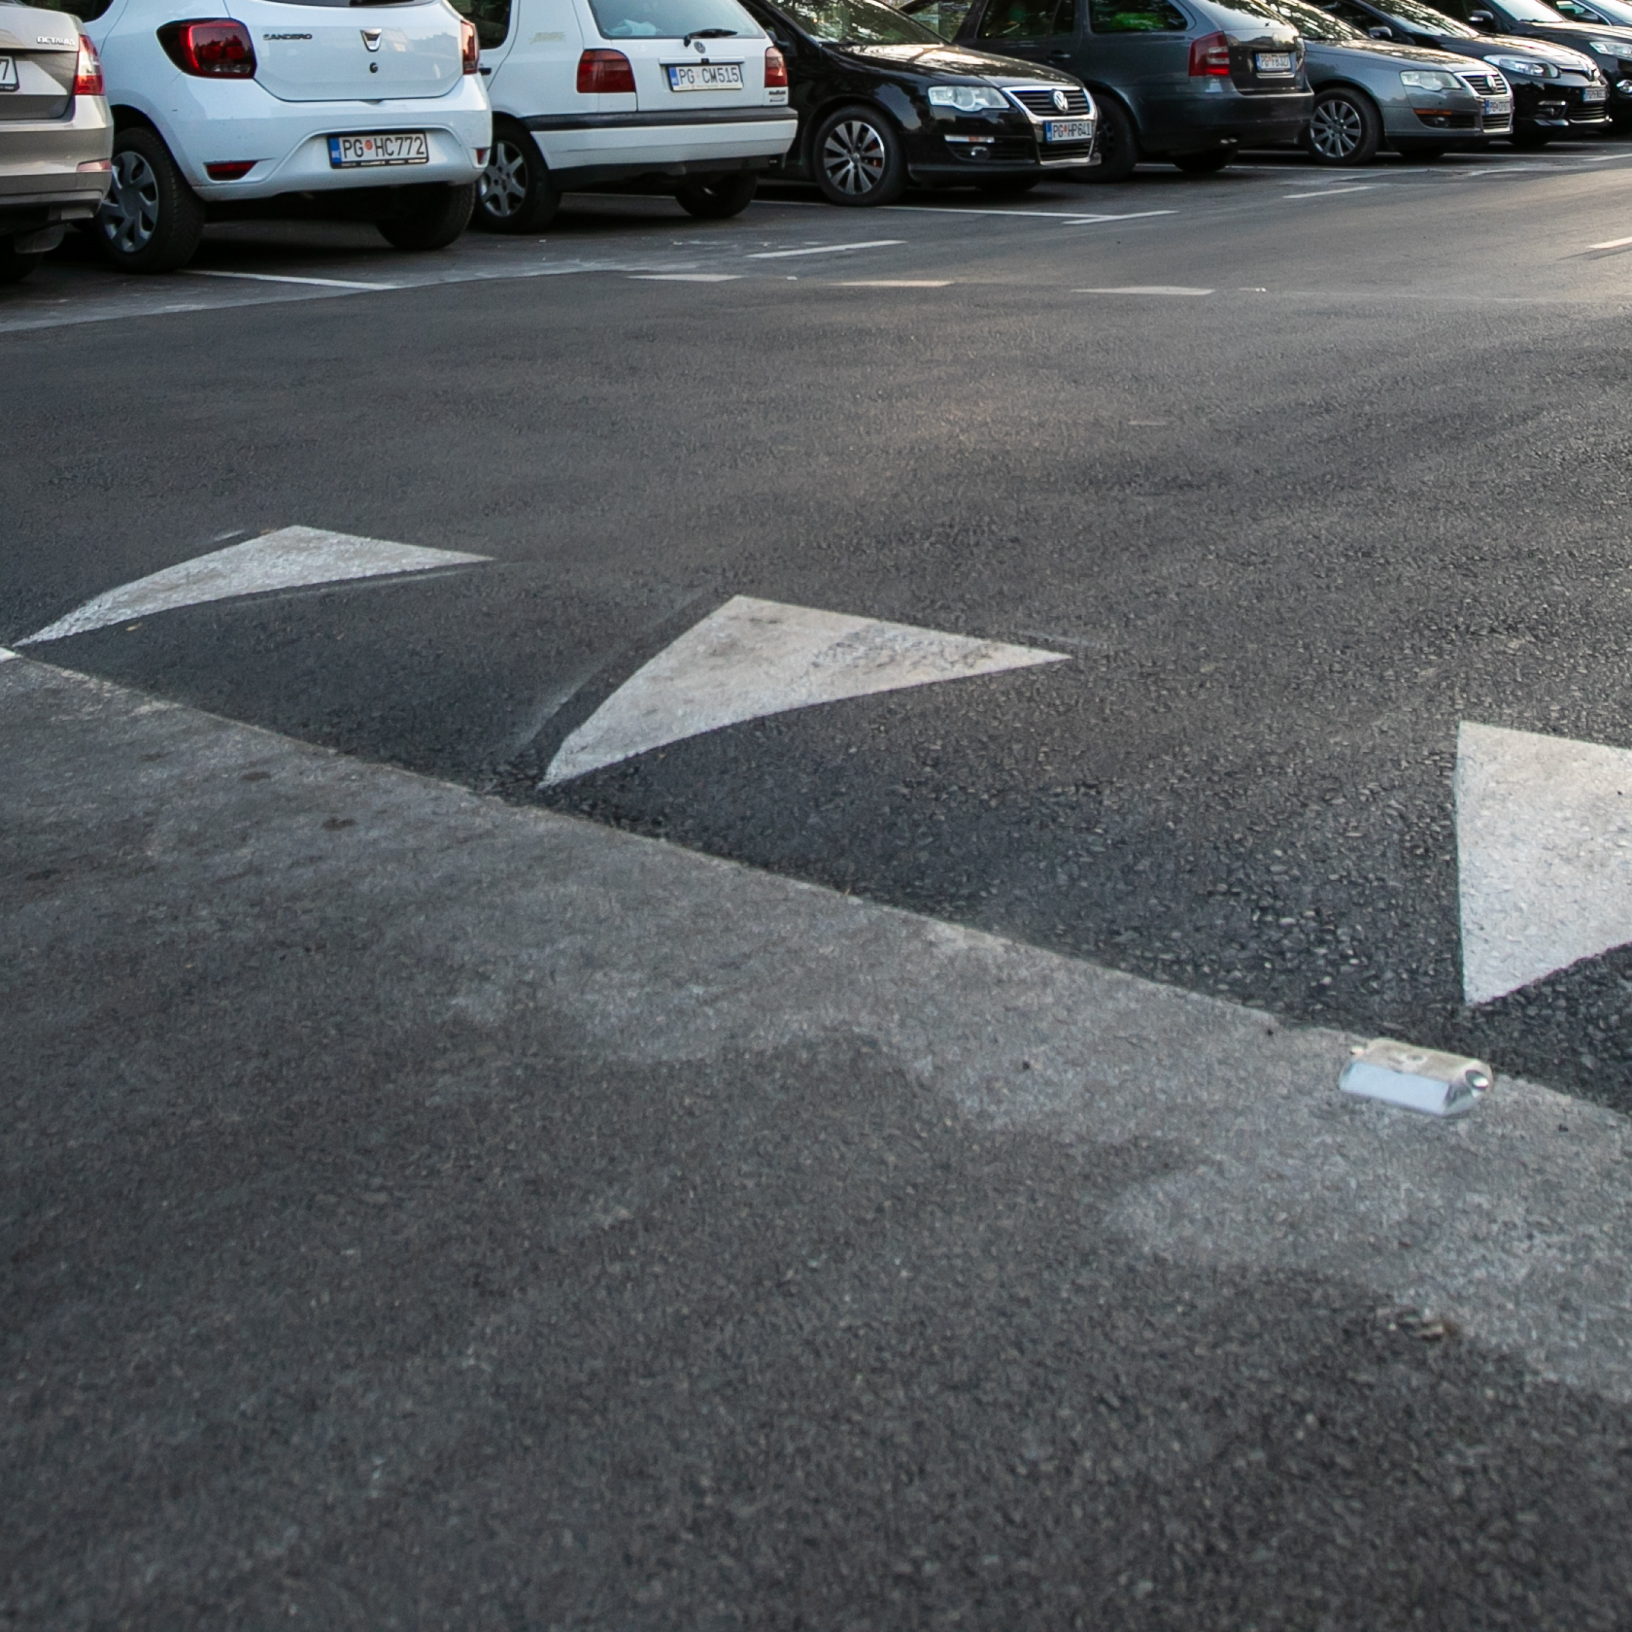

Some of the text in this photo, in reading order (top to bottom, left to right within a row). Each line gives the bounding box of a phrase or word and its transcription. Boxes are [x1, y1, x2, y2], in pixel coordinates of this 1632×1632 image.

[36, 36, 75, 46] OCTAVIA
[263, 33, 313, 41] SANDERO
[678, 67, 739, 85] PG CM515
[342, 138, 364, 159] PG
[373, 136, 425, 157] HC772
